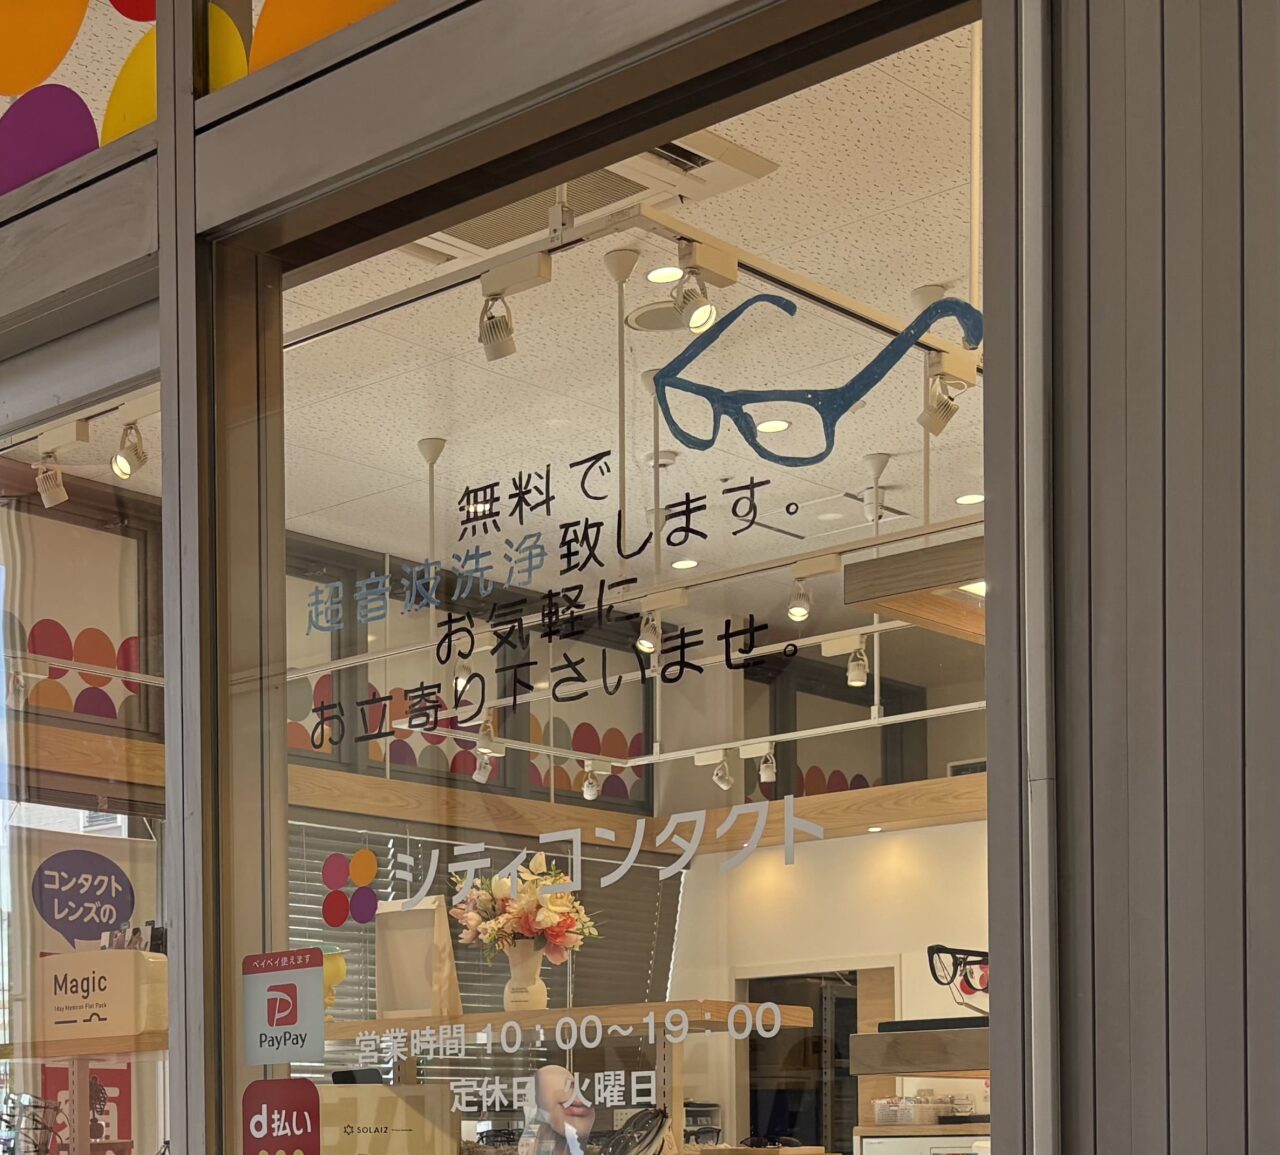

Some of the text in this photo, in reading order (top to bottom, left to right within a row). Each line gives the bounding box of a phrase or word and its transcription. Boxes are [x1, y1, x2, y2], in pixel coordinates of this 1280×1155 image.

[457, 449, 612, 541] 無料で
[435, 577, 641, 666] お気軽に
[310, 613, 799, 750] お立寄り下さいませ。
[393, 794, 824, 911] シティコンタクト
[43, 870, 123, 898] コンタクト
[53, 898, 117, 924] レンズの
[252, 954, 311, 968] ペイペイ使えます
[53, 970, 107, 999] Magic
[259, 1030, 307, 1050] PayPay
[355, 1022, 466, 1065] 営業時間
[449, 1070, 658, 1112] 定休日 火曜日
[249, 1104, 312, 1138] d払い
[357, 1125, 389, 1134] SOLAIZ
